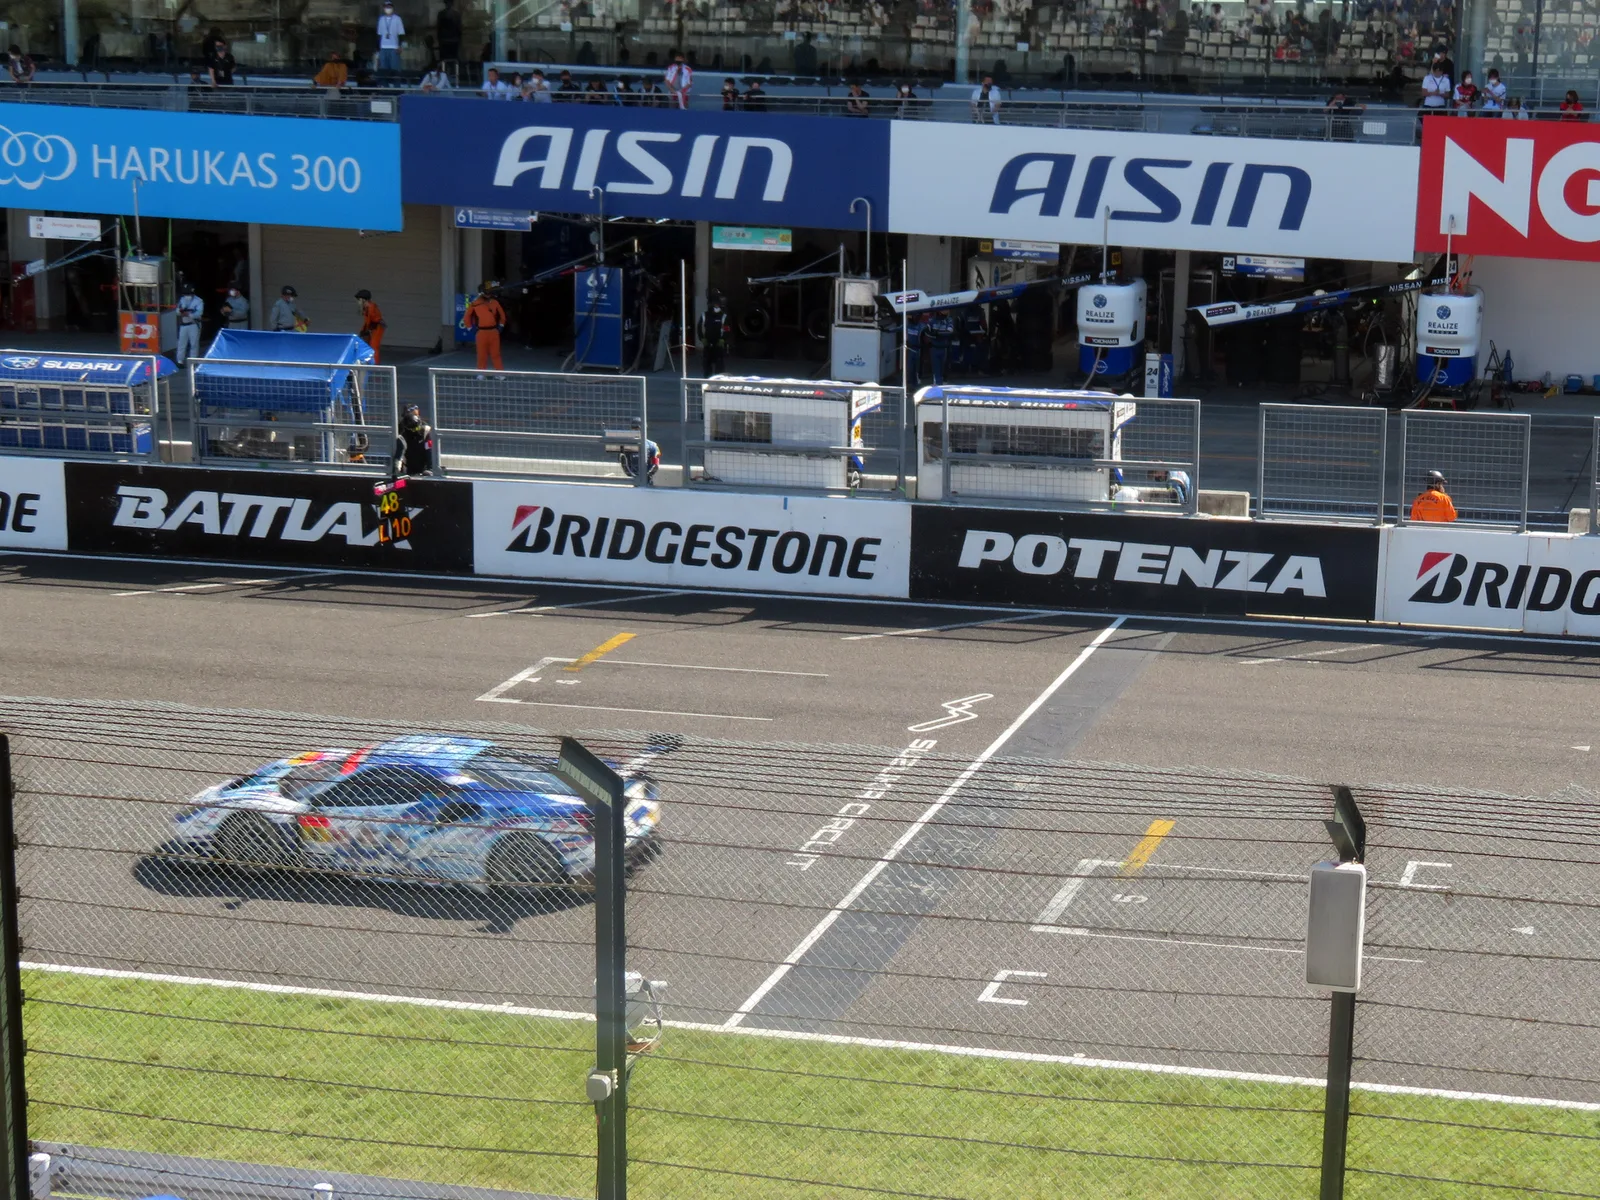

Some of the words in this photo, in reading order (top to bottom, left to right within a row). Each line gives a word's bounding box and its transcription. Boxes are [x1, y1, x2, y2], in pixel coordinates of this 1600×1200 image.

[92, 144, 279, 189] HARUKAS
[290, 154, 362, 194] 300
[493, 126, 793, 202] AISIN
[988, 152, 1312, 231] AISIN
[1440, 135, 1600, 243] NG
[457, 209, 473, 223] 61
[1224, 259, 1234, 267] 24
[1061, 274, 1091, 285] NISSAN
[1388, 281, 1423, 292] NISSAN
[936, 296, 959, 306] REALIZE
[1086, 310, 1115, 318] REALIZE
[1251, 307, 1277, 317] REALIZE
[42, 360, 123, 371] SUBARU
[1147, 367, 1158, 376] 24
[719, 384, 773, 394] NISSAN
[380, 492, 399, 514] 48
[379, 525, 390, 543] L
[393, 516, 411, 538] 10
[505, 504, 882, 580] BRIDGESTONE
[957, 529, 1327, 598] POTENZA
[1408, 552, 1600, 615] BRIDG
[786, 802, 871, 871] CIRCUIT
